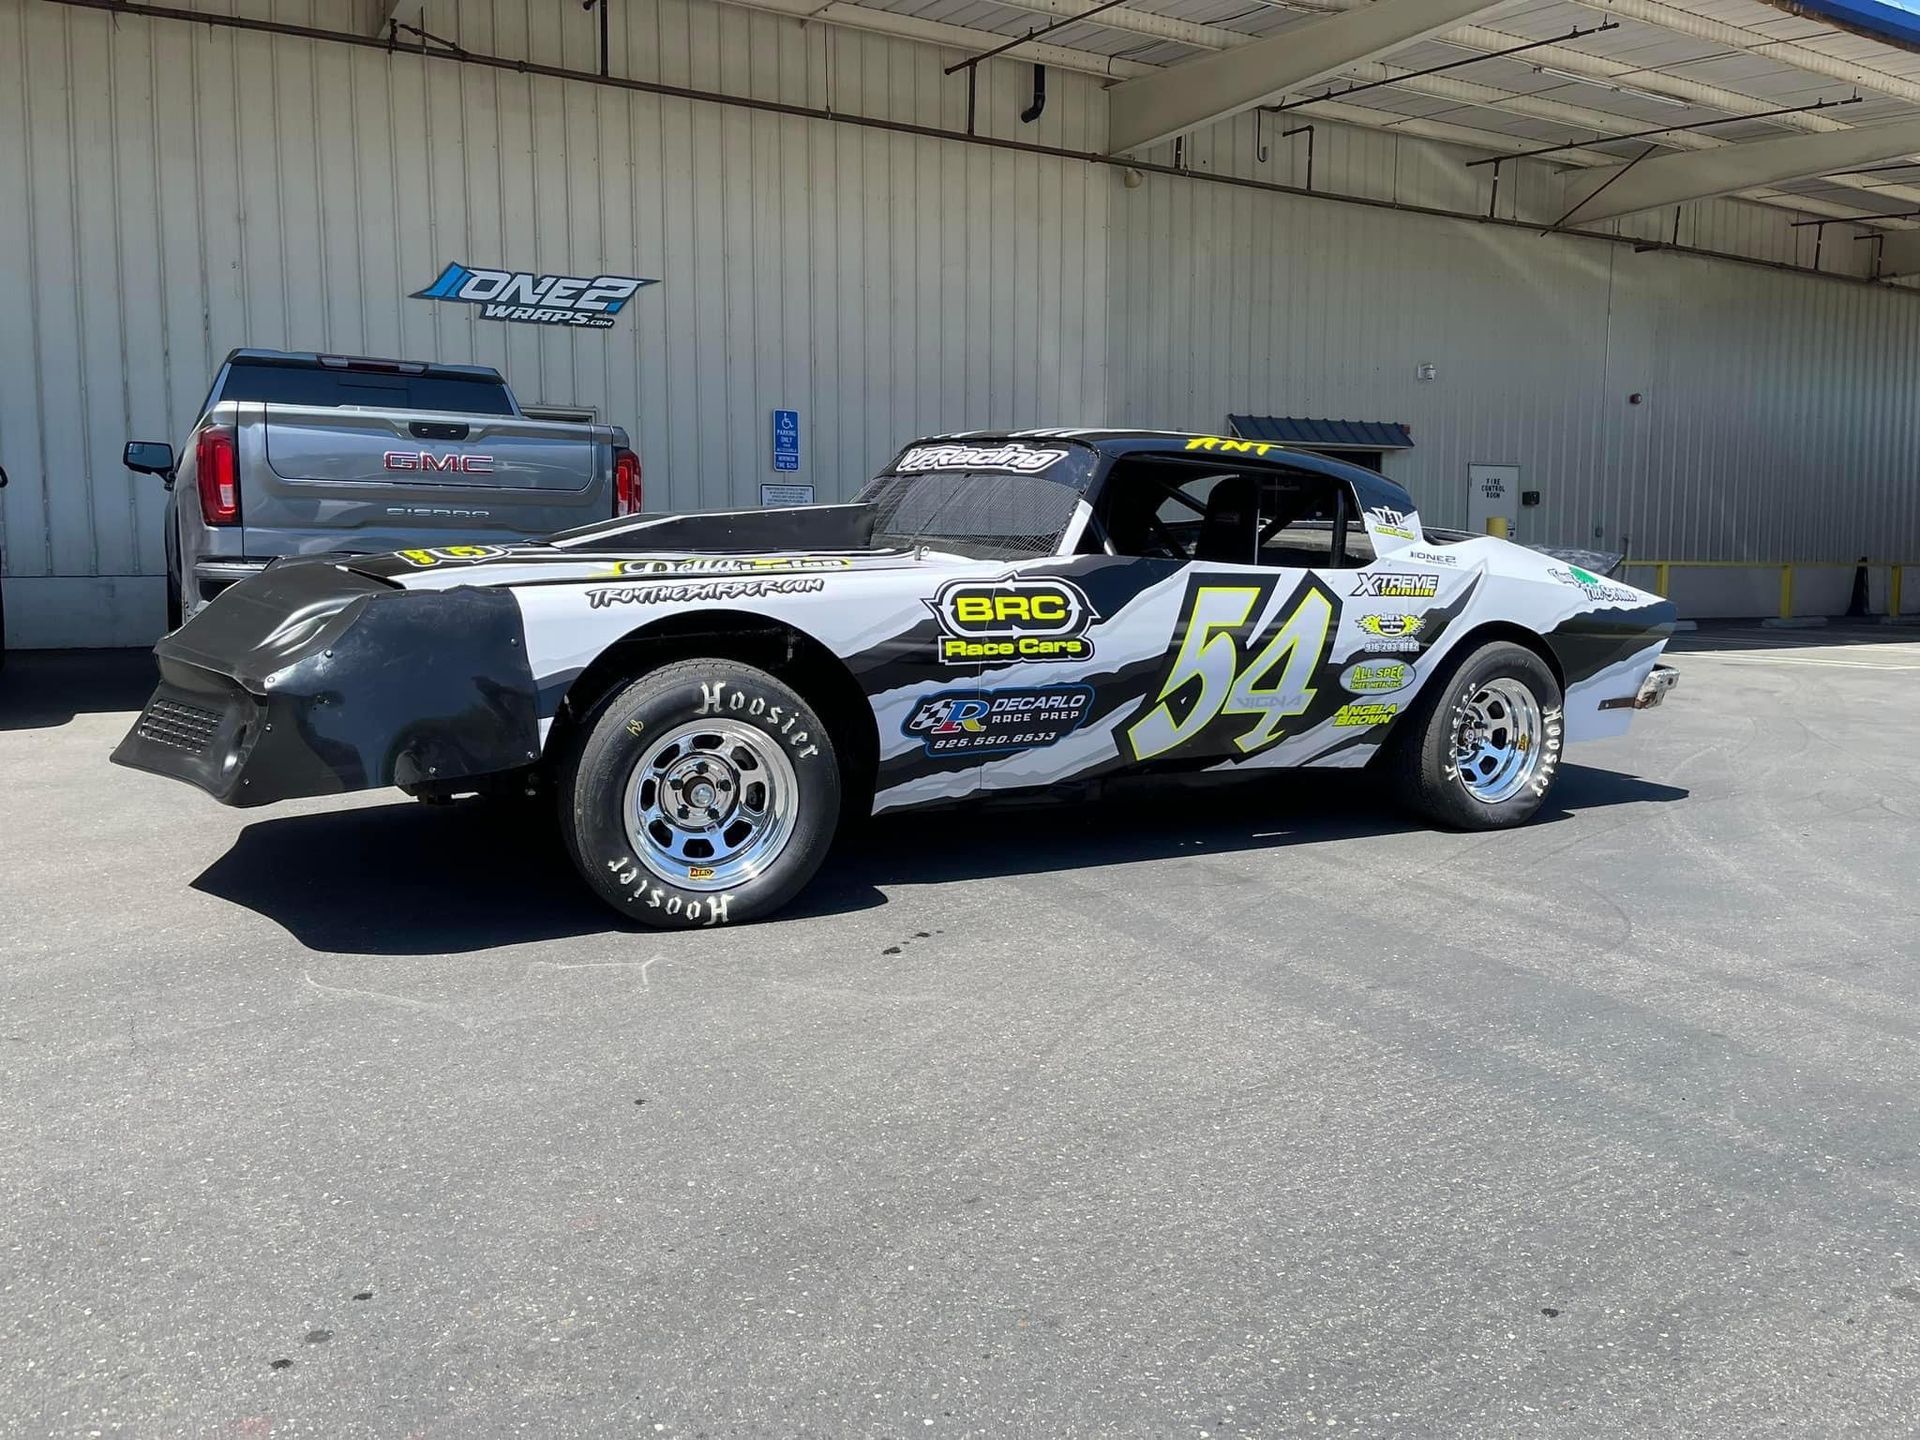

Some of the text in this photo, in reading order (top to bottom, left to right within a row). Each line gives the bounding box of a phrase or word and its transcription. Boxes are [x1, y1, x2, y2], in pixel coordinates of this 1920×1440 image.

[459, 268, 648, 312] ONE2
[383, 450, 494, 475] GMC
[1481, 485, 1505, 493] CONTROL
[1486, 478, 1501, 486] FIRE
[386, 507, 491, 519] SIERRA
[1350, 572, 1440, 597] XTREME
[956, 595, 1066, 622] BRC
[945, 637, 1082, 657] Race Cars
[1126, 585, 1319, 762] 54
[1352, 663, 1405, 681] ALL SPEC
[990, 694, 1087, 713] DECARLO
[1333, 703, 1398, 717] ANGELA
[693, 680, 819, 759] Hoosier
[991, 710, 1080, 724] RACE PREP
[1333, 714, 1394, 726] BROWN
[607, 856, 736, 926] Hoosier
